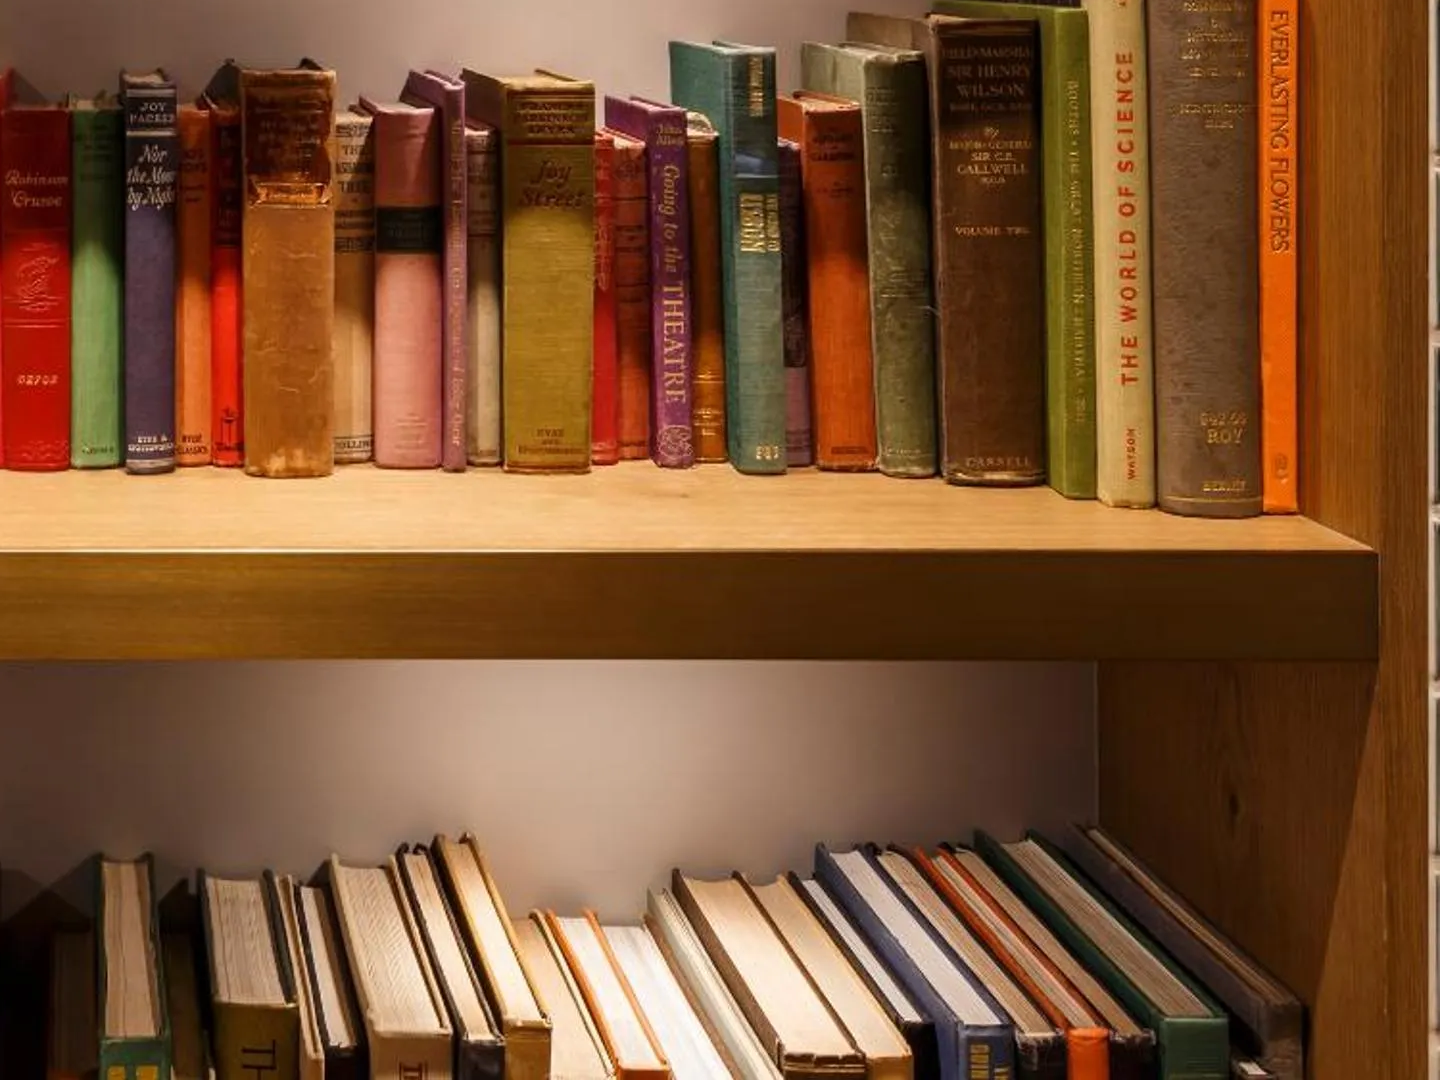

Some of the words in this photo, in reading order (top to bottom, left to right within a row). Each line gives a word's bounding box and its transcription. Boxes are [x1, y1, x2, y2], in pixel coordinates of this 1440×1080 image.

[956, 81, 1026, 98] WILSON
[1270, 8, 1291, 152] EVERLASTING
[139, 102, 166, 113] JOY
[1115, 50, 1135, 175] SCIENCE
[533, 159, 571, 185] Joy
[660, 164, 680, 218] Going
[10, 189, 63, 208] Crusoe
[1118, 182, 1136, 218] OF
[1271, 158, 1295, 254] FLOWERS
[662, 222, 676, 240] to
[664, 244, 684, 273] the
[1118, 228, 1138, 321] WORLD
[661, 281, 688, 405] THEATRE
[1121, 330, 1139, 386] THE
